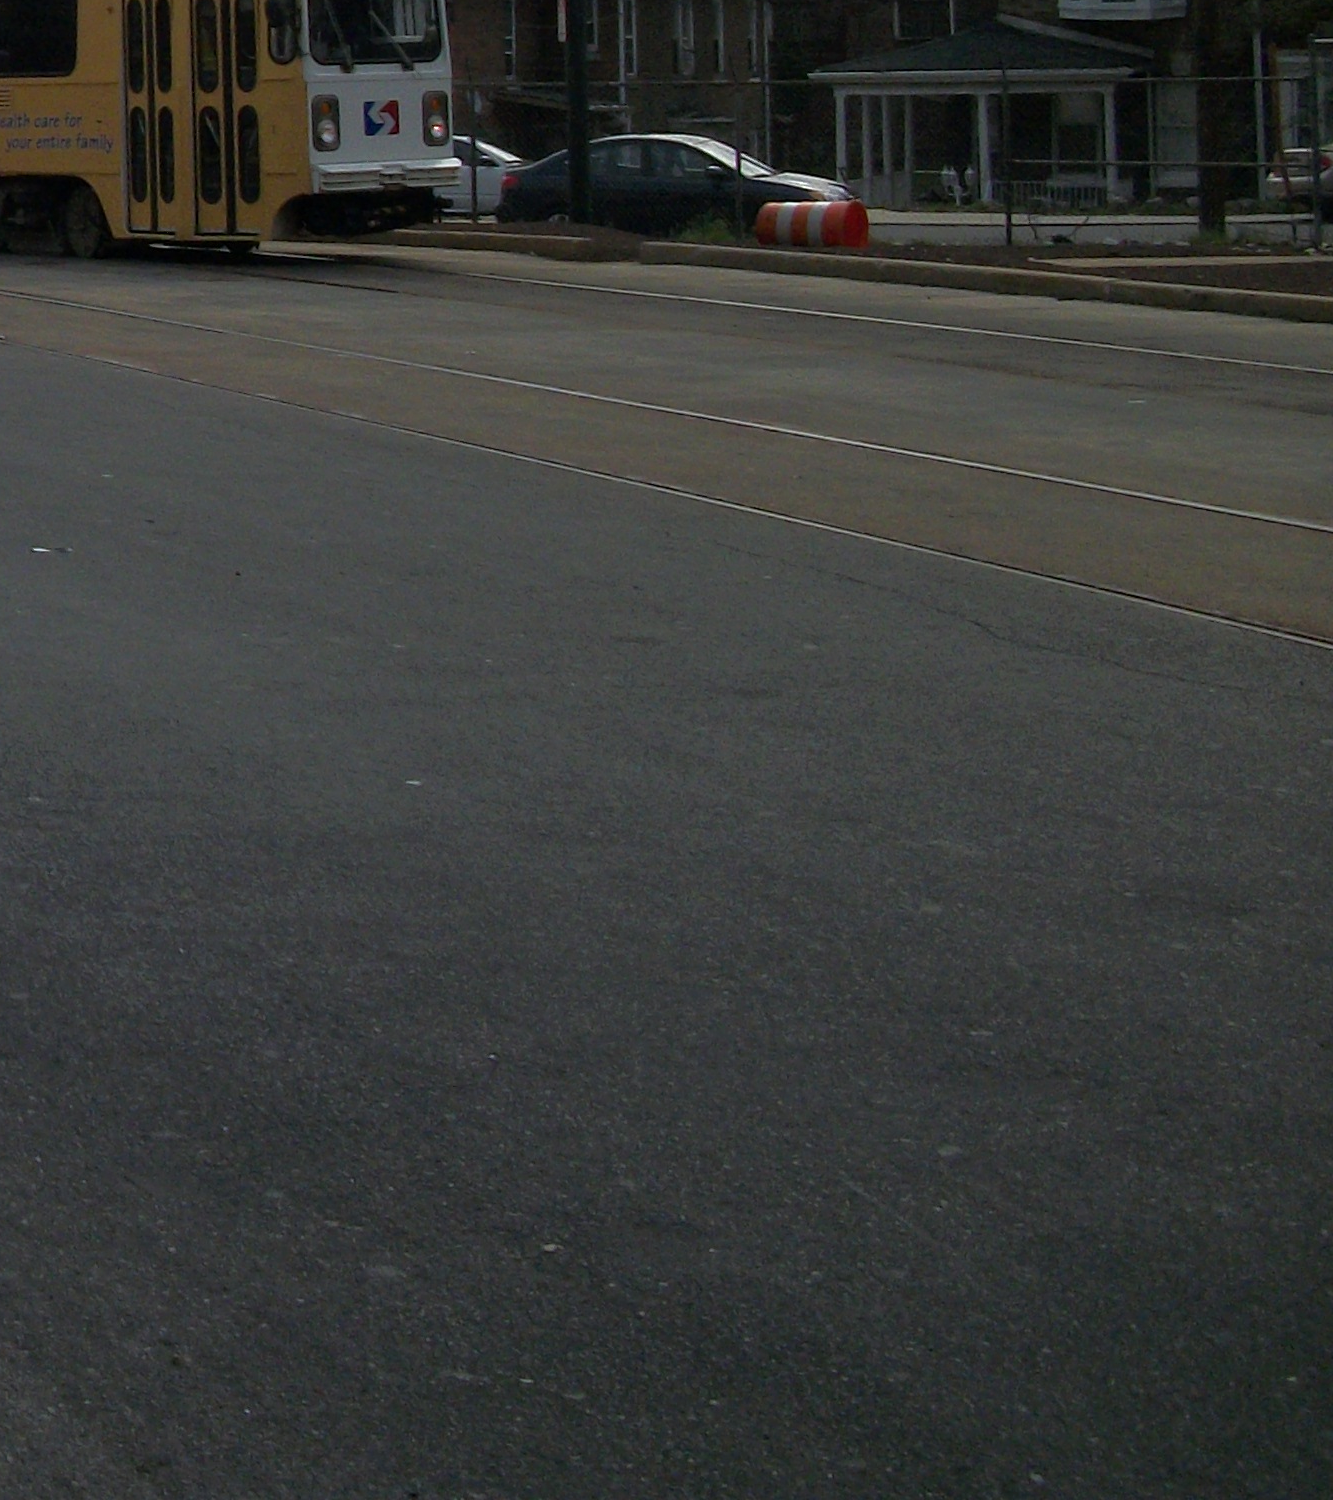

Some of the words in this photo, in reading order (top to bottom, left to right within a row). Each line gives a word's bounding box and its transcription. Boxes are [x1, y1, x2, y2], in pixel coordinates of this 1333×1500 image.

[34, 116, 60, 128] care
[64, 112, 82, 127] for
[5, 137, 32, 153] your
[36, 136, 71, 149] entire
[76, 132, 114, 154] family
